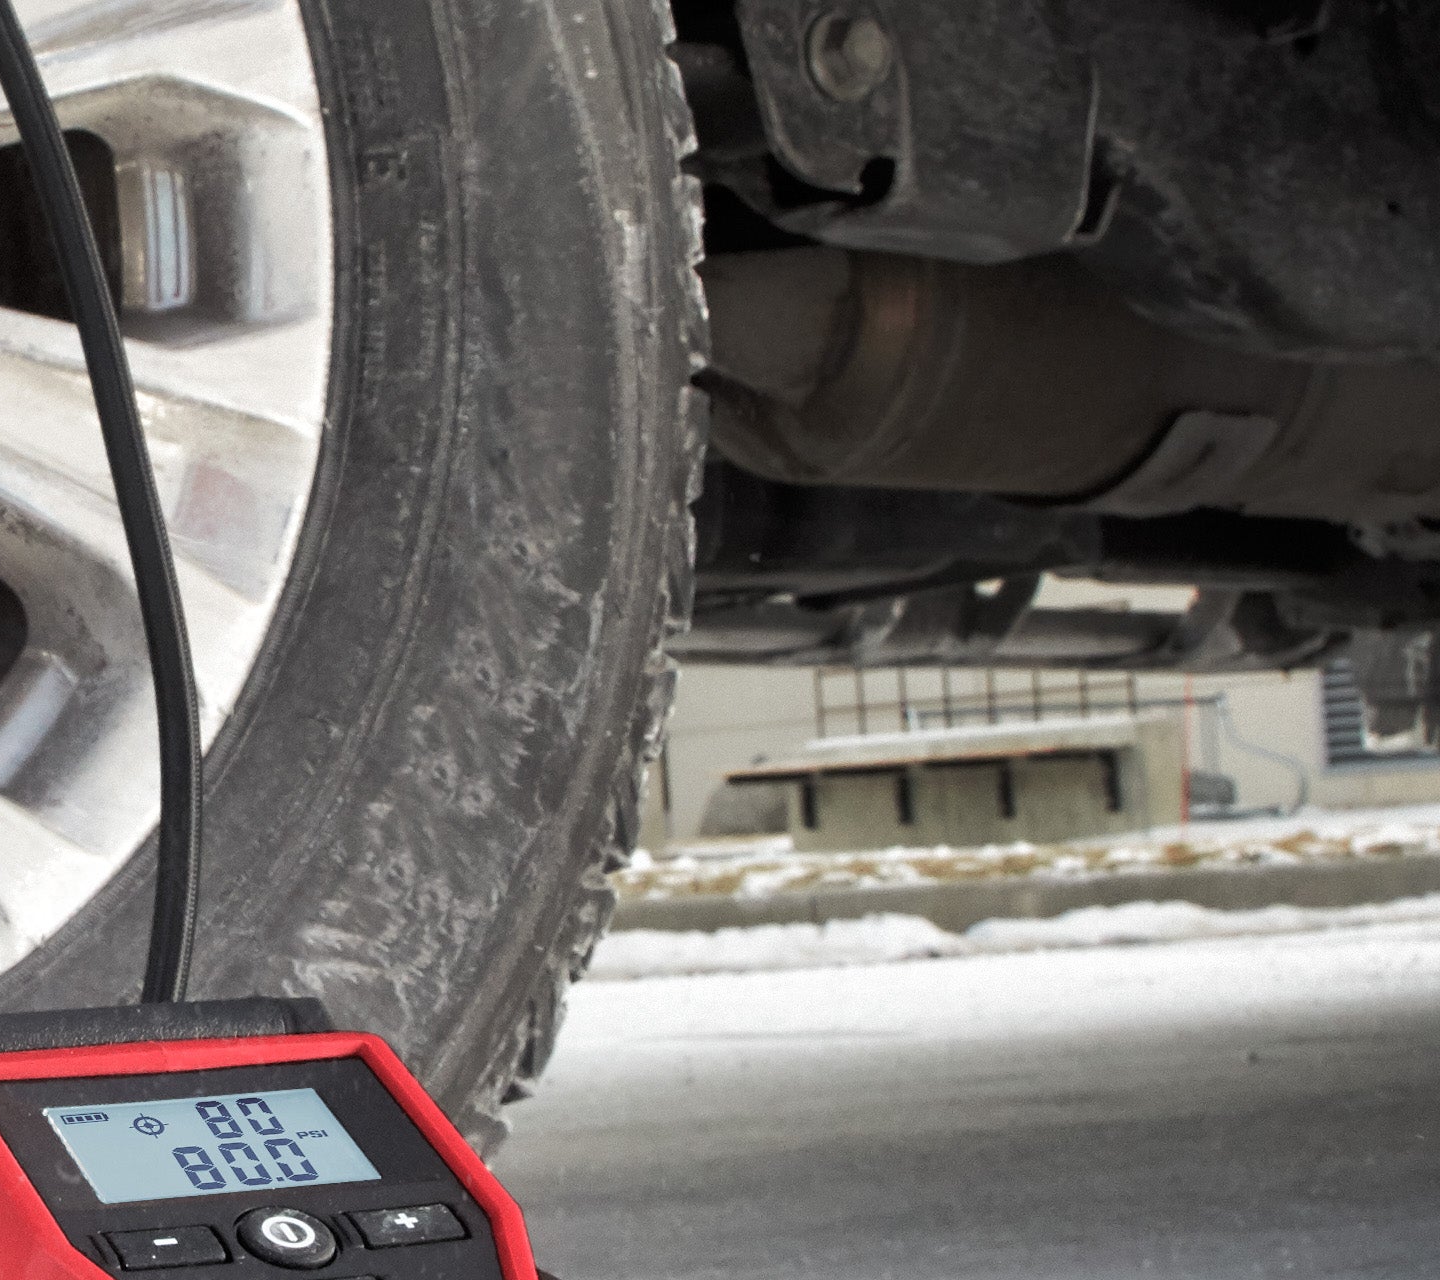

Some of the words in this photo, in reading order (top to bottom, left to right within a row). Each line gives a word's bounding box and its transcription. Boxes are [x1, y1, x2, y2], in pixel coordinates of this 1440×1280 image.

[195, 1097, 284, 1139] 80
[296, 1130, 328, 1139] PSI
[172, 1138, 319, 1190] 80.0
